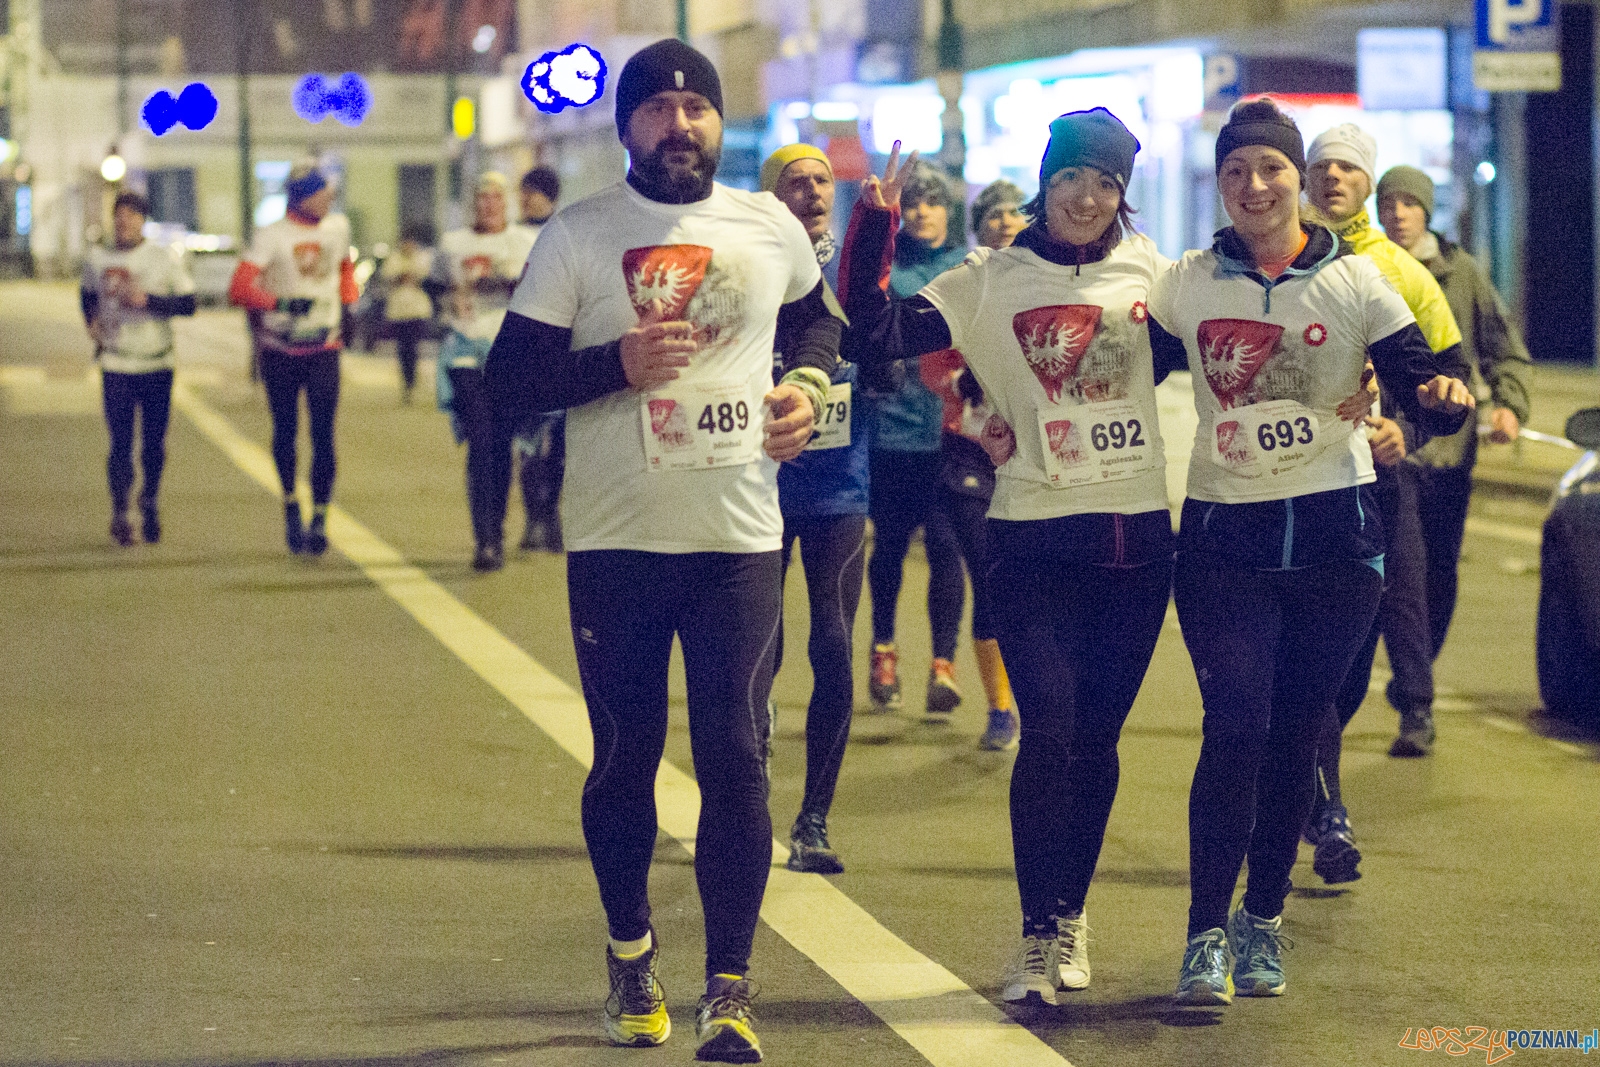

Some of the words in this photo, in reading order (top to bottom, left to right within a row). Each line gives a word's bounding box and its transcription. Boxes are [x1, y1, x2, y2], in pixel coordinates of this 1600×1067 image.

[1488, 0, 1541, 42] P
[697, 400, 749, 434] 489
[814, 401, 847, 426] 79
[1090, 418, 1146, 451] 692
[1257, 416, 1314, 451] 693
[1100, 454, 1143, 466] Agnieszka
